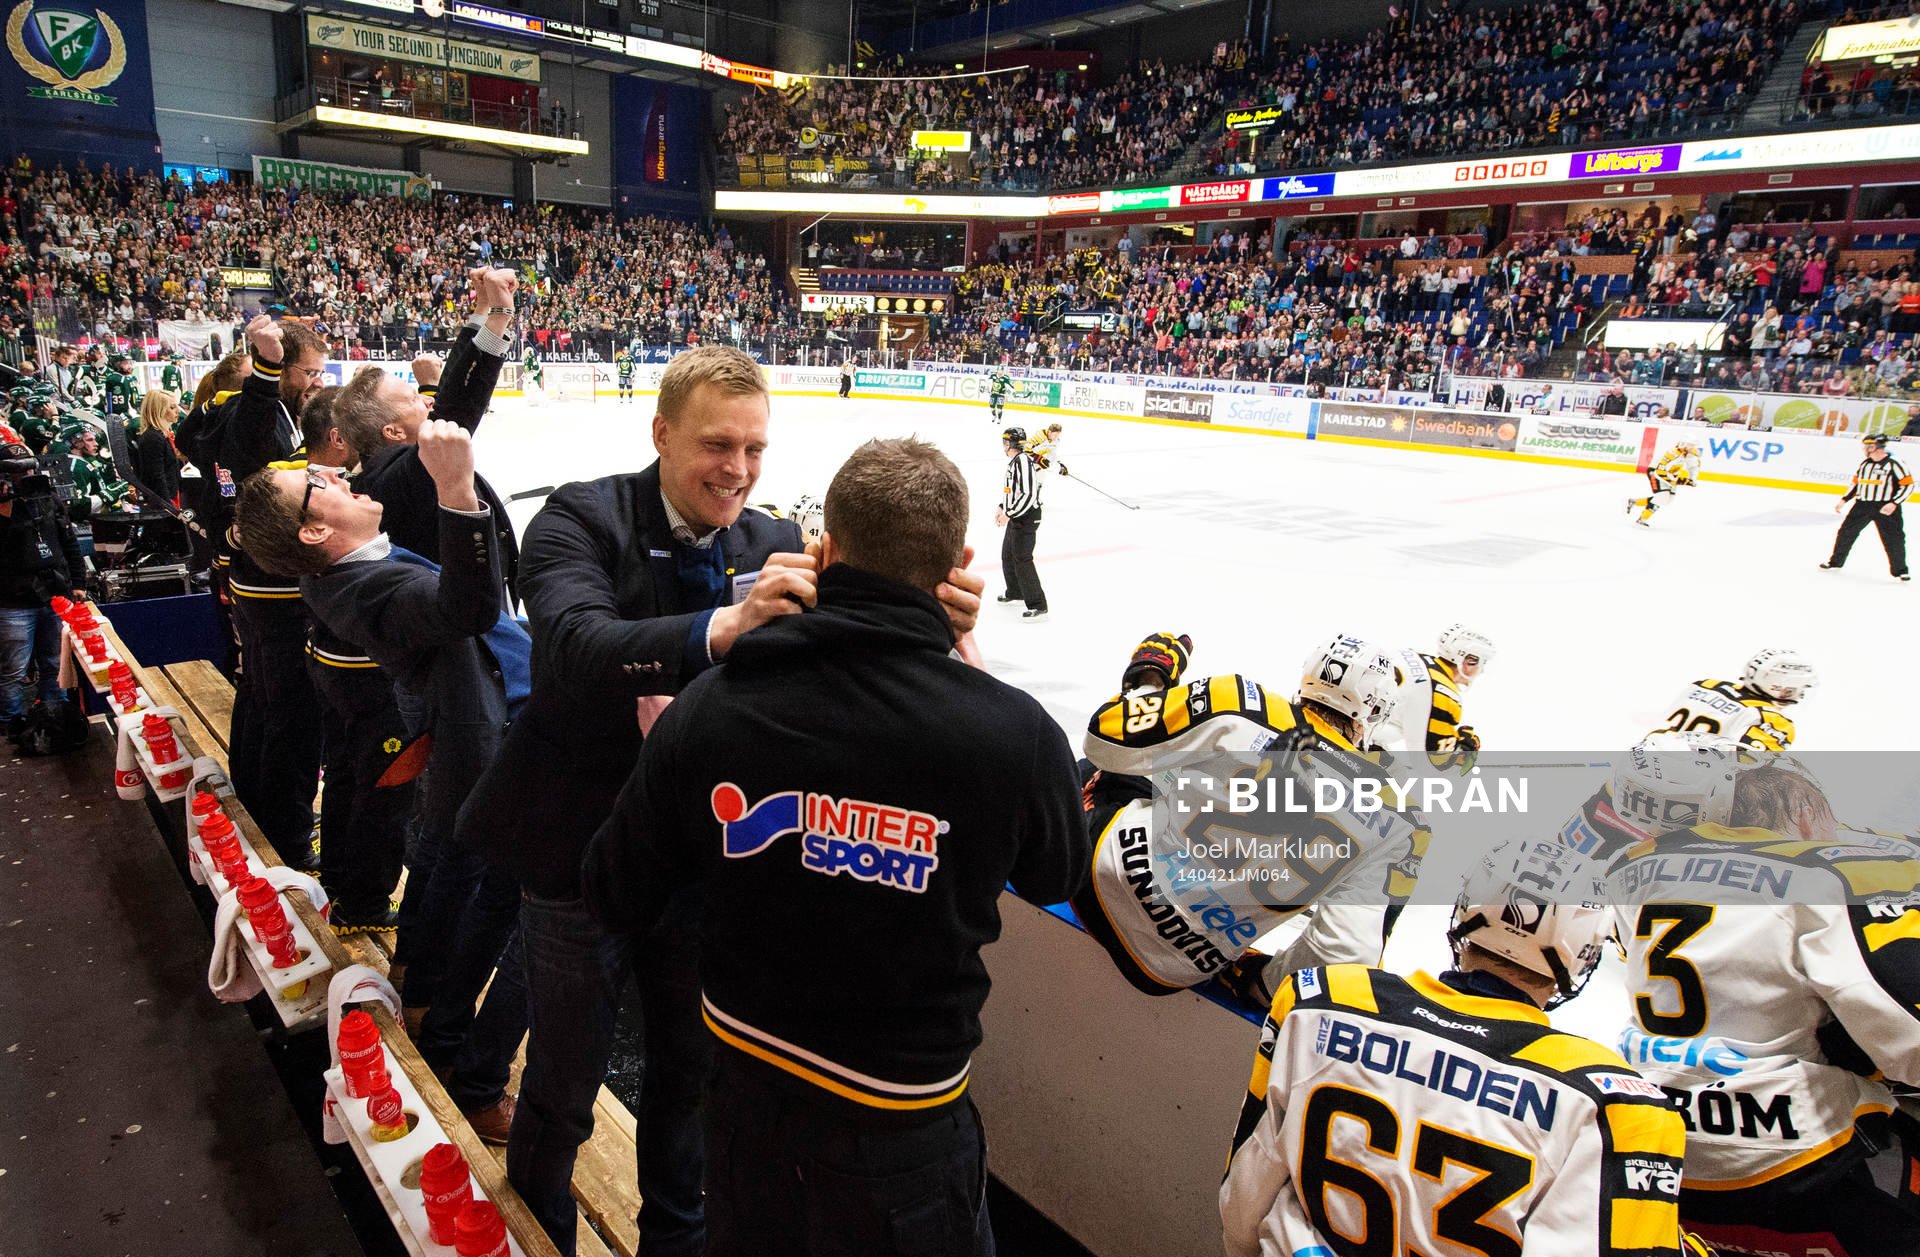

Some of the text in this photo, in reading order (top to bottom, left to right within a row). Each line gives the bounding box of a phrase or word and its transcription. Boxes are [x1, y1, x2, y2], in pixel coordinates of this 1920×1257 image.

[49, 15, 70, 41] F
[61, 34, 83, 60] BK
[352, 28, 503, 70] YOUR SECOND LIVINGROOM
[45, 88, 101, 102] KARLSTAD
[259, 158, 411, 197] BRYGGERIET
[1585, 153, 1663, 173] Löfbergs
[821, 295, 868, 305] BILLES
[857, 374, 924, 388] BRUNZELLS
[1145, 392, 1213, 417] stadium
[1227, 403, 1294, 427] Scandjet
[1323, 413, 1386, 428] KARLSTAD
[1415, 418, 1494, 437] Swedbank
[1522, 436, 1636, 456] LARSSON-RESMAN
[1709, 437, 1785, 464] WSP
[809, 528, 819, 537] 41
[1126, 696, 1163, 734] 29
[1318, 740, 1362, 774] Reebok
[805, 792, 937, 853] INTER
[801, 831, 939, 894] SPORT
[1624, 856, 1794, 899] BOLIDEN
[1118, 826, 1228, 974] SUNDQVIS
[1635, 899, 1718, 1039] 3
[1316, 1015, 1331, 1056] NEW
[1412, 1006, 1490, 1038] Reebok
[1325, 1019, 1558, 1132] BOLIDEN
[1658, 1080, 1801, 1140] RÖM
[1300, 1082, 1536, 1257] 63
